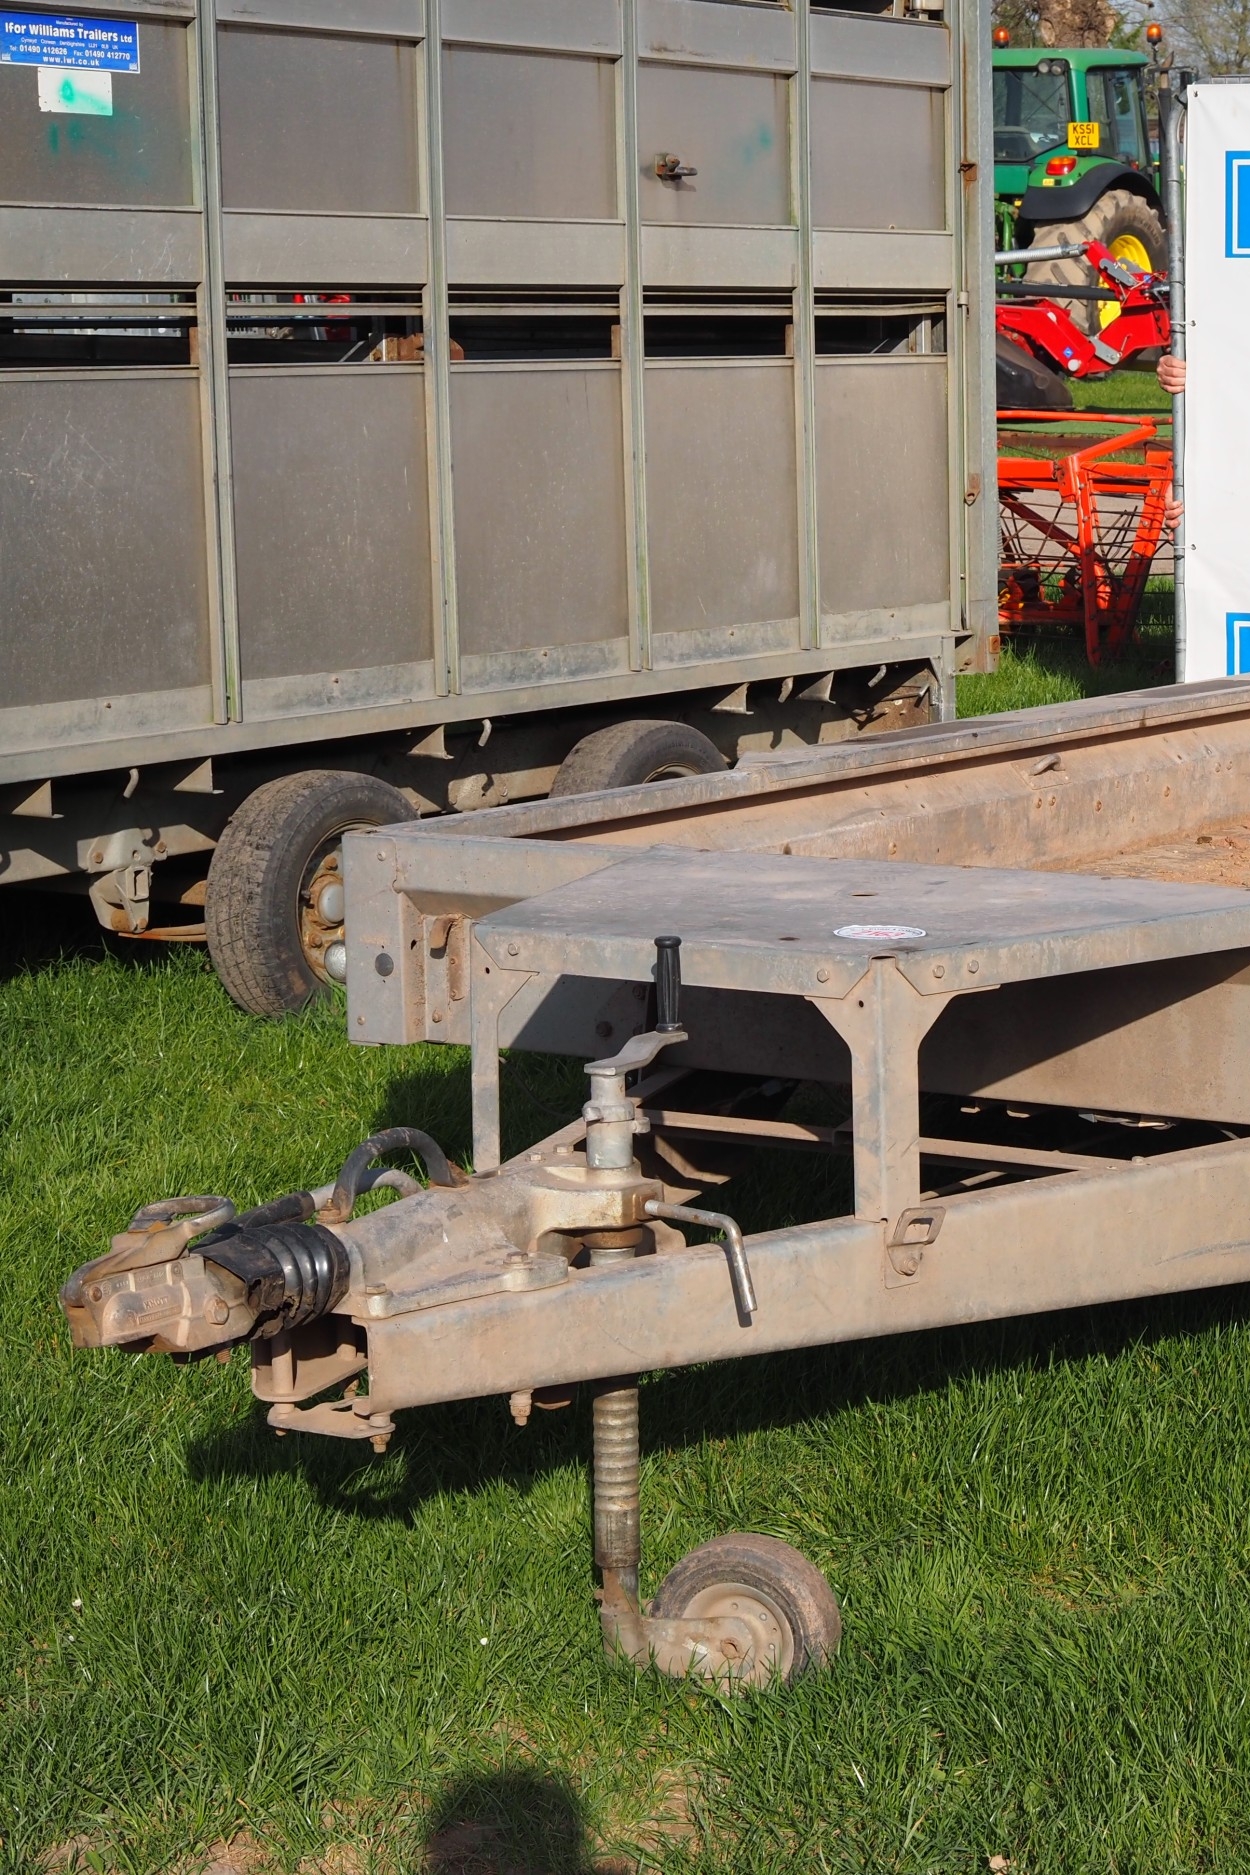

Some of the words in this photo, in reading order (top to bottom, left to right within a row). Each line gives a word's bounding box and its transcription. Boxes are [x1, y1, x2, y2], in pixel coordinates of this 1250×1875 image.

[5, 22, 26, 34] Ifor
[29, 24, 75, 38] Williams
[77, 28, 118, 42] Trailers
[120, 35, 133, 43] Ltd
[19, 44, 41, 53] 01490
[84, 49, 105, 59] 01490
[107, 52, 131, 60] 412770
[42, 55, 100, 66] www.iwt.co.uk
[1072, 124, 1095, 134] KS51
[1074, 135, 1093, 146] XCL
